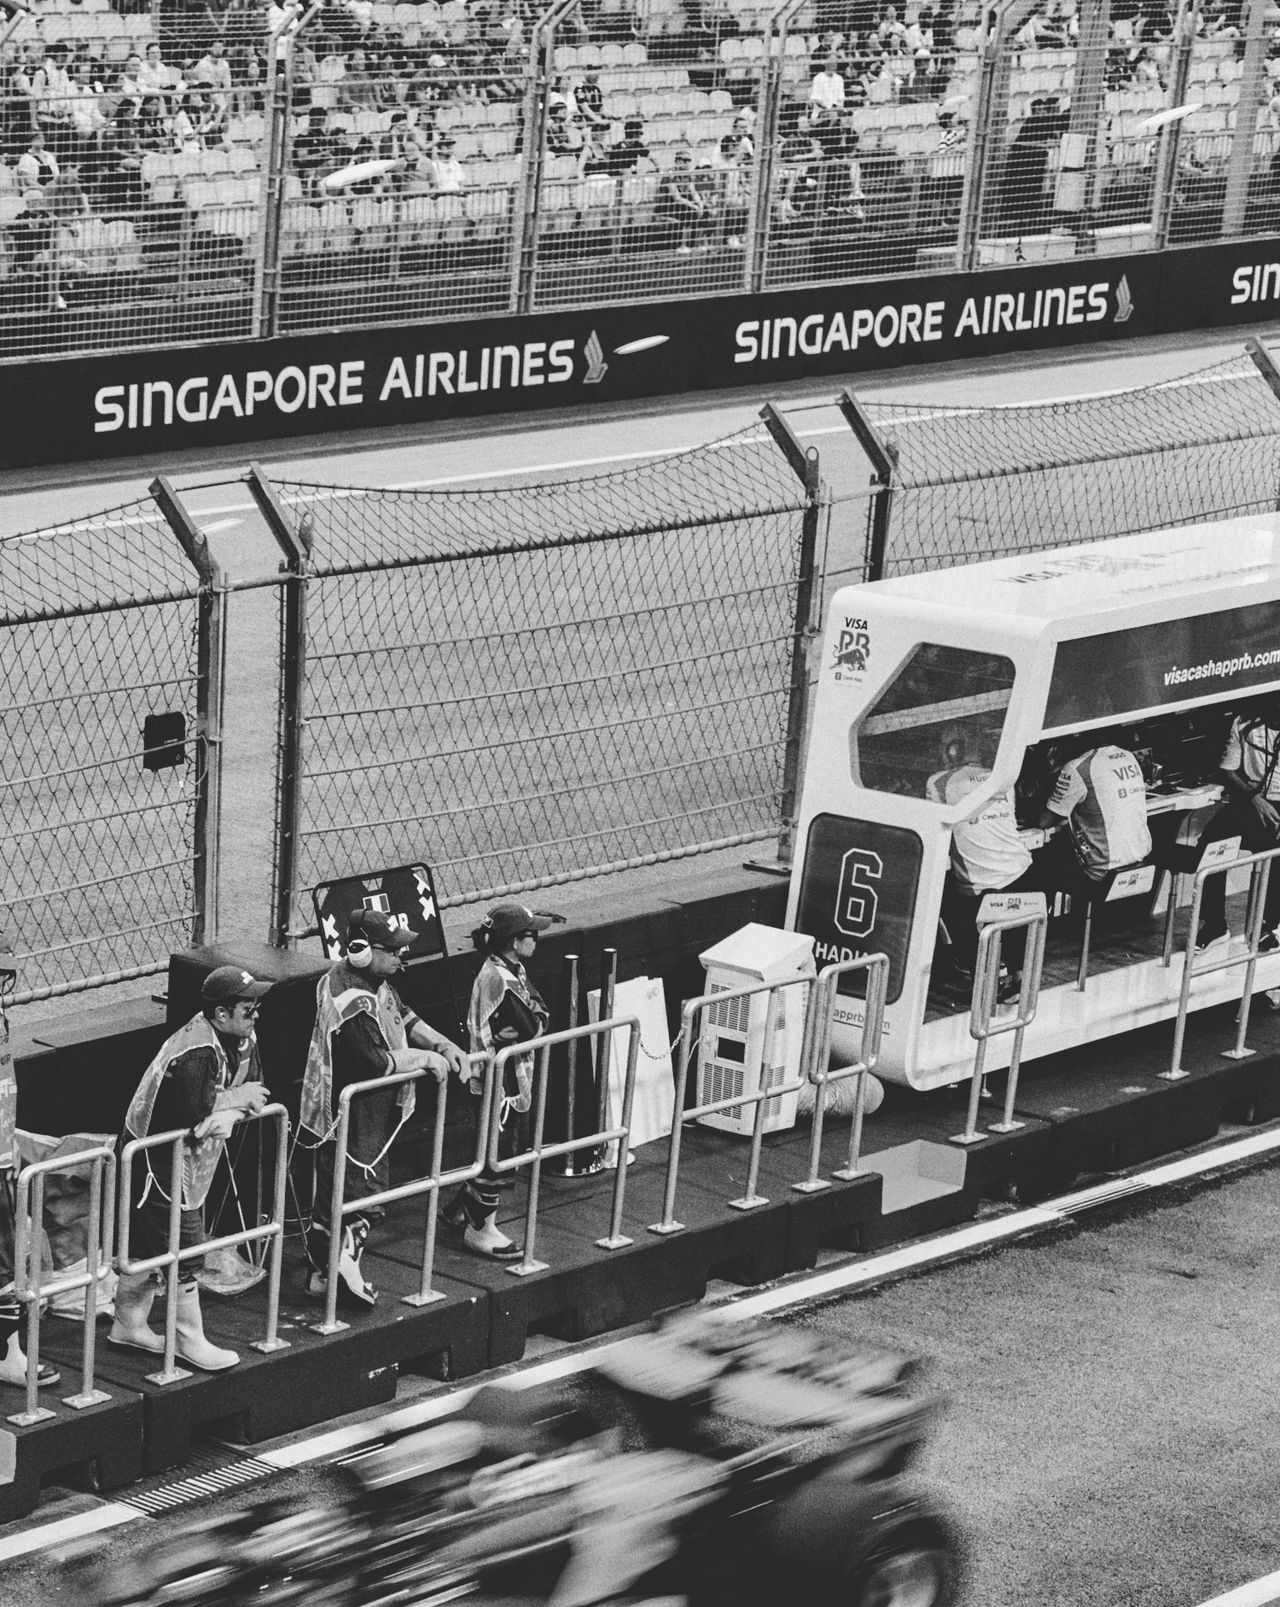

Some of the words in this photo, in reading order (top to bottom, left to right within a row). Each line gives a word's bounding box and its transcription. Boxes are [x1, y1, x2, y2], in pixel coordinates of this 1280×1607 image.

[734, 301, 946, 363] SINGAPORE
[954, 283, 1110, 338] AIRLINES
[94, 359, 365, 433] SINGAPORE
[379, 339, 575, 401] AIRLINES
[844, 616, 868, 631] VISA
[1164, 649, 1280, 686] visacashapprb.com
[833, 847, 884, 938] 6
